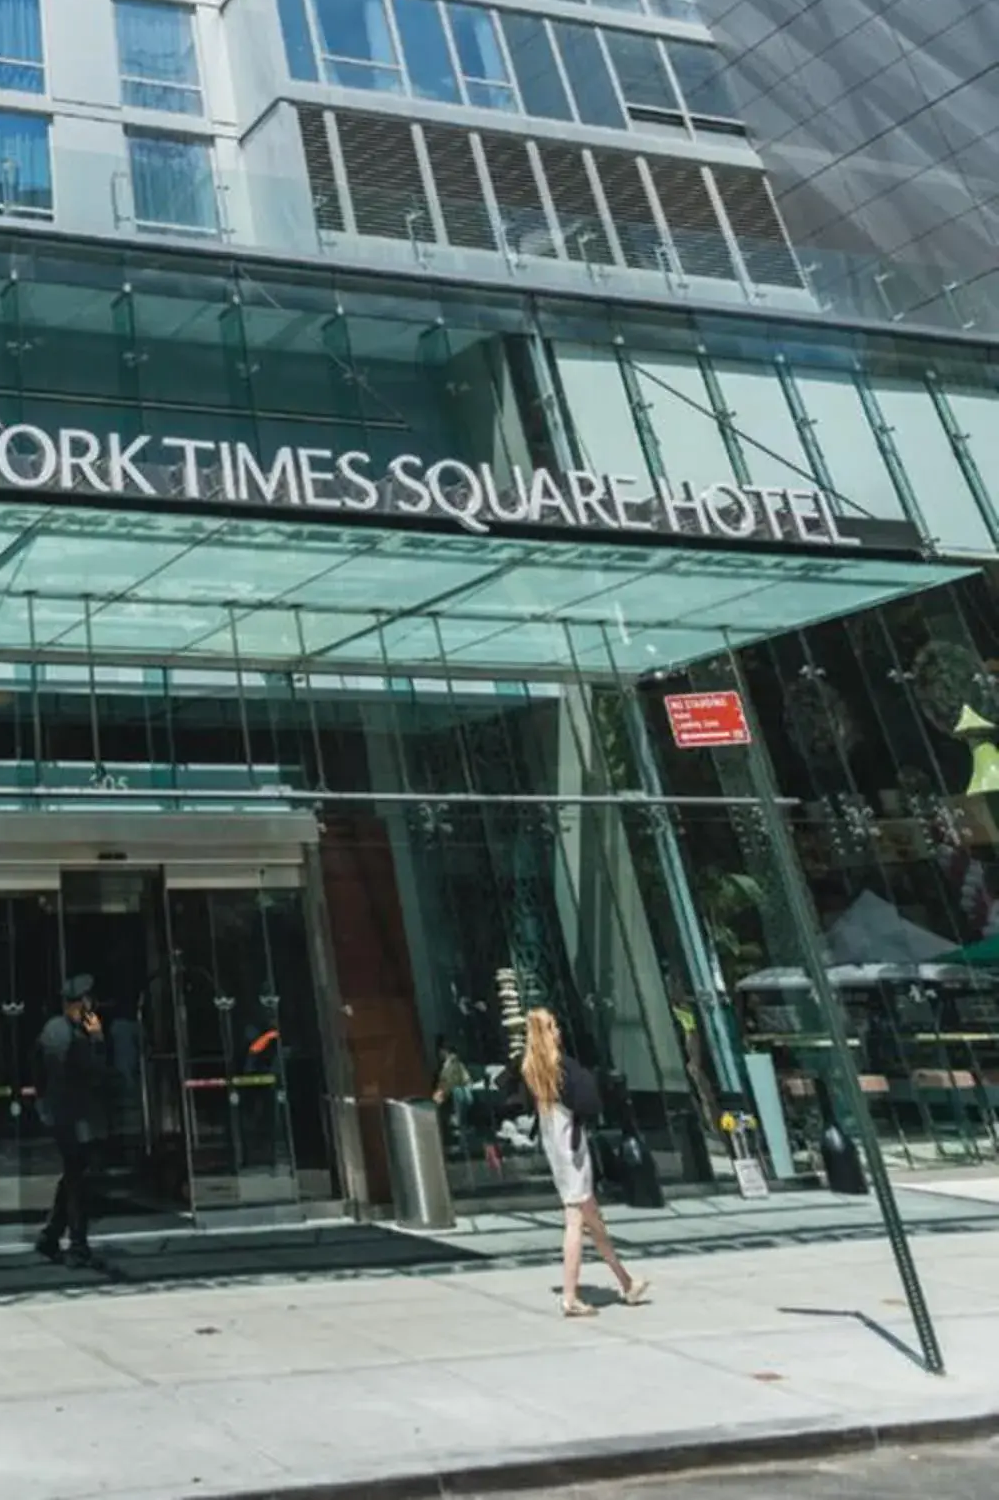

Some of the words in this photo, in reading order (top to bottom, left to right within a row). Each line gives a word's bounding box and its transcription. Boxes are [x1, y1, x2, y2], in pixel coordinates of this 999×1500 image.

[162, 438, 379, 510] TIMES
[389, 455, 653, 532] SQUARE
[661, 481, 861, 545] HOTEL
